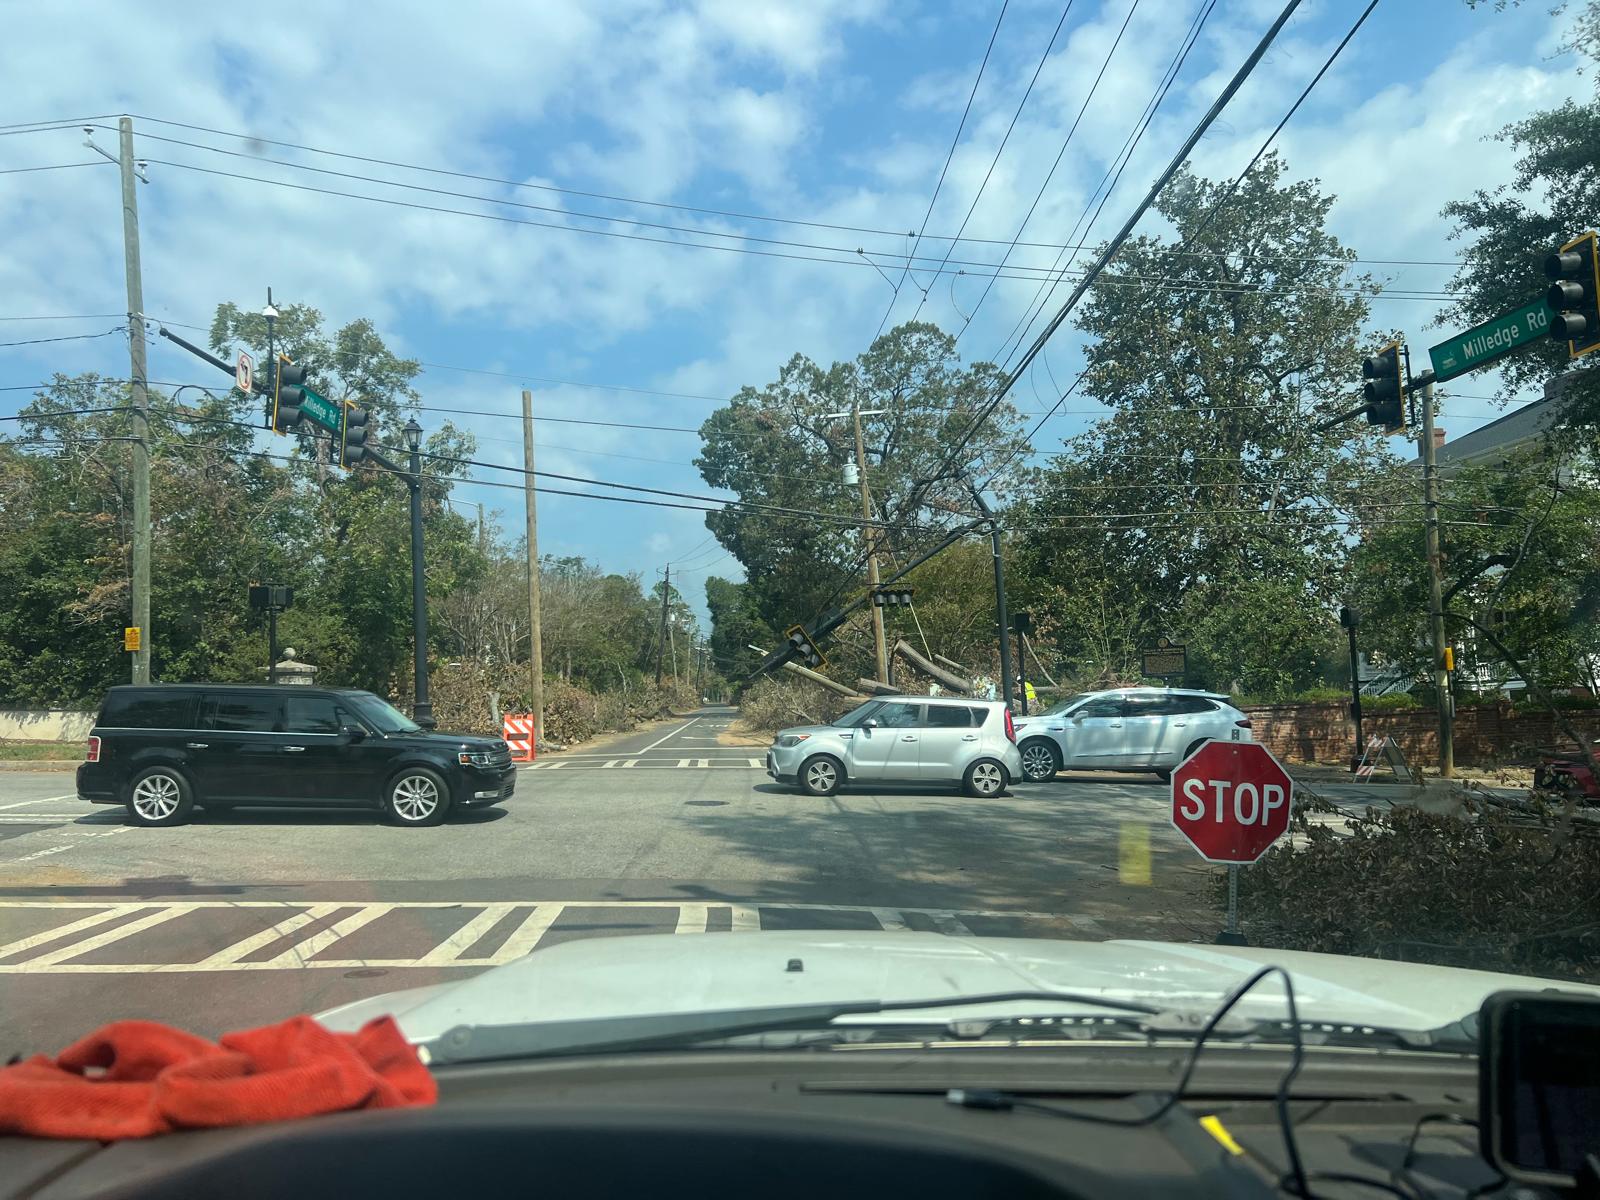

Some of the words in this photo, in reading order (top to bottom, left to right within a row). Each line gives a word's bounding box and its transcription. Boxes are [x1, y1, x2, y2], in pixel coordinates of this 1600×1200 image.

[1462, 324, 1519, 360] Milledge
[1526, 307, 1547, 331] Rd
[328, 410, 336, 424] Rd
[1180, 778, 1285, 826] STOP
